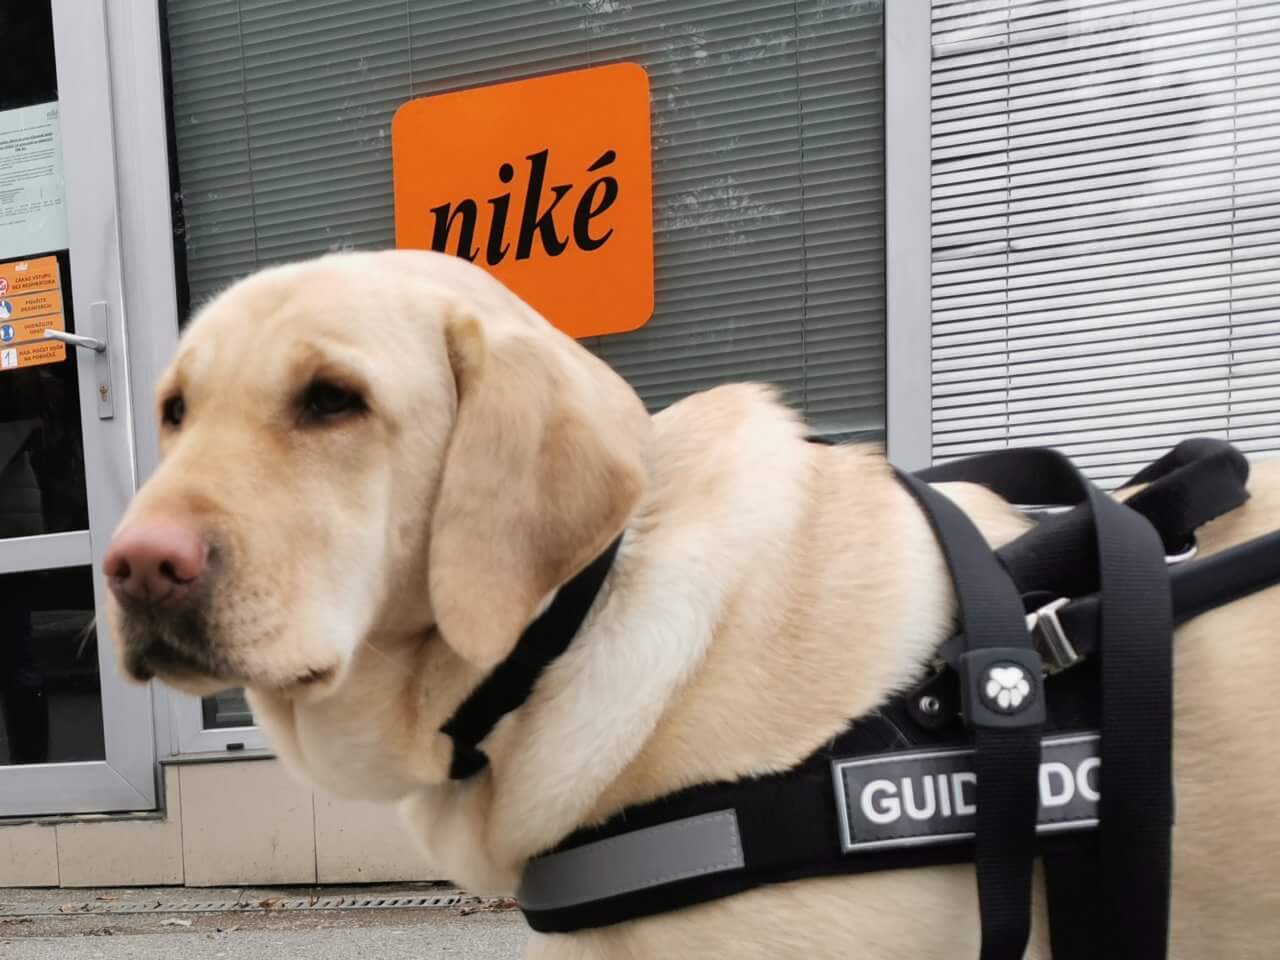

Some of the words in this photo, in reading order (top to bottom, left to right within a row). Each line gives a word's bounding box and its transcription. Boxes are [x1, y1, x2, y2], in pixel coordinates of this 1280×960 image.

[429, 148, 619, 266] niké
[861, 772, 977, 824] GUID
[1039, 757, 1102, 807] DO
